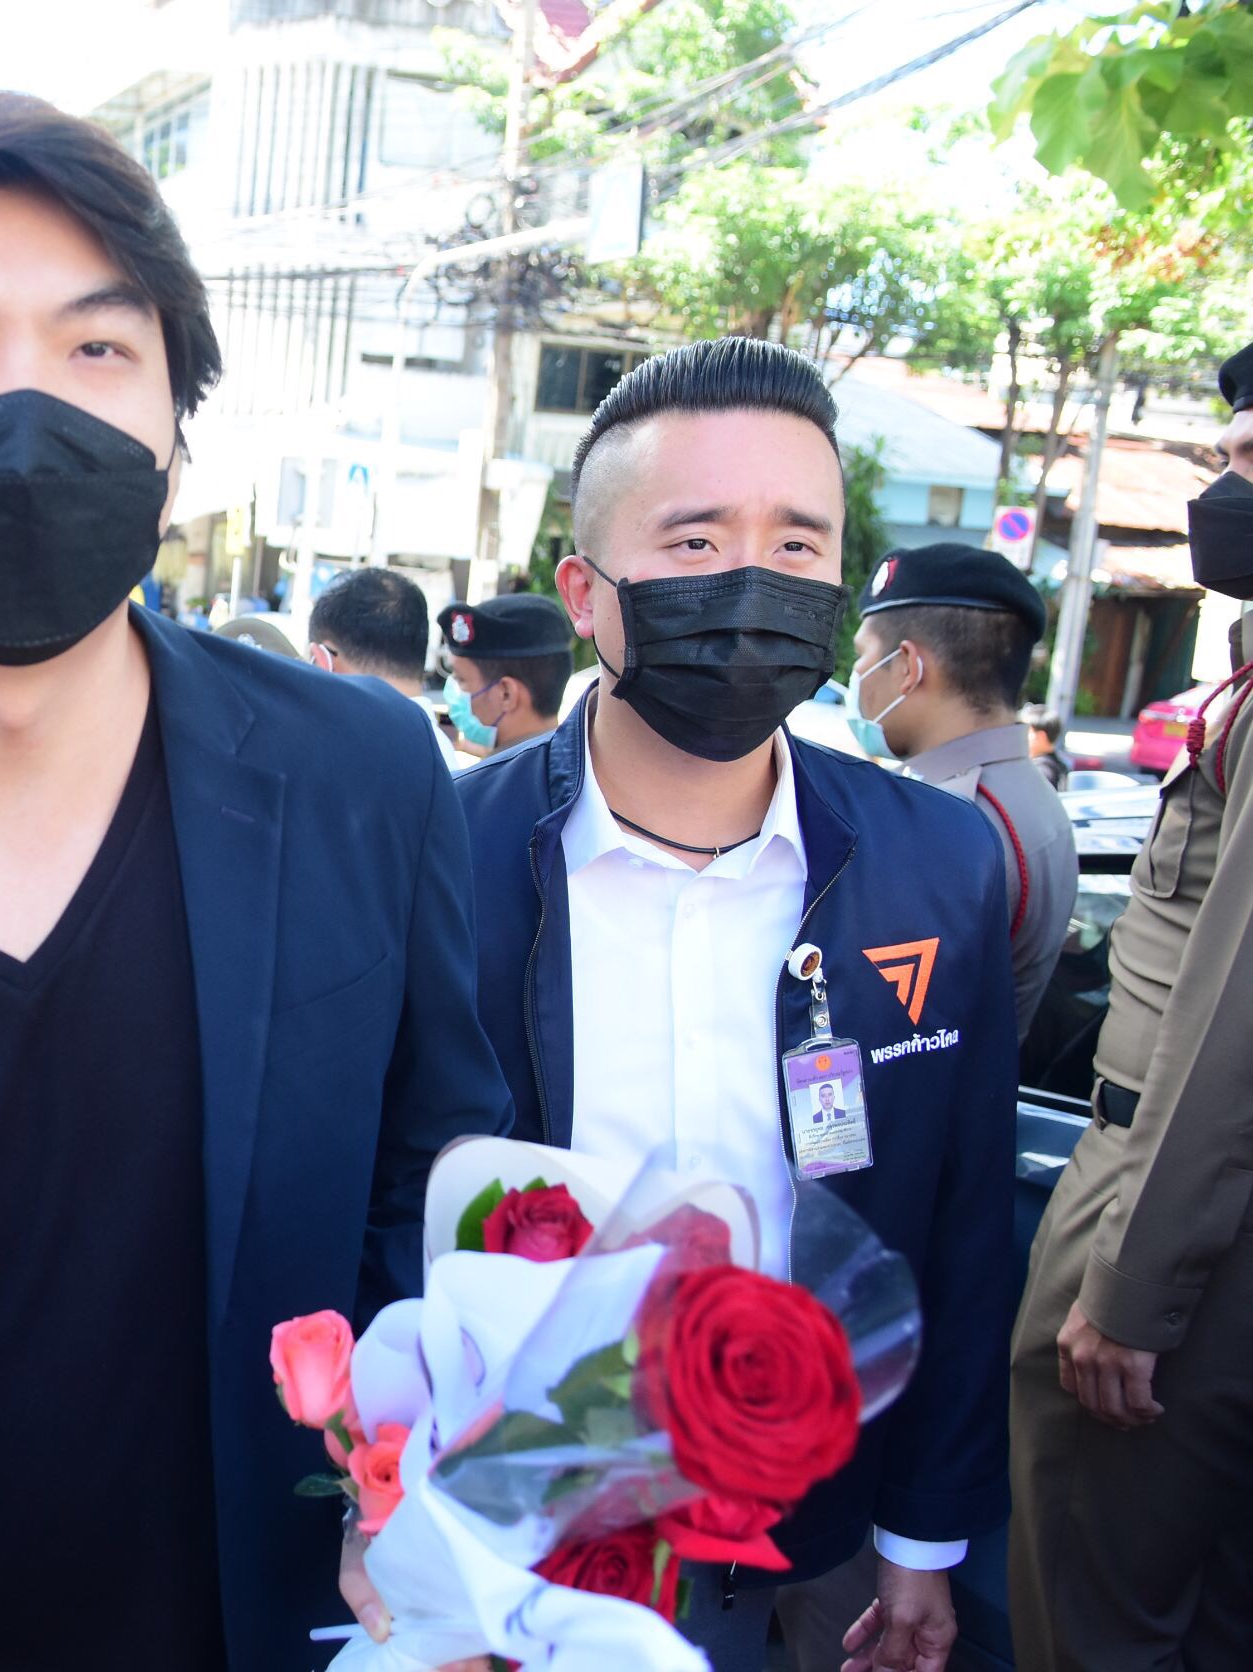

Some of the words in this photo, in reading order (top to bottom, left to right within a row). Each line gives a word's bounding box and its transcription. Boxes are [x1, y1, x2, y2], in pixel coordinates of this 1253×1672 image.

[870, 1029, 959, 1063] พรรคก้าวไกล
